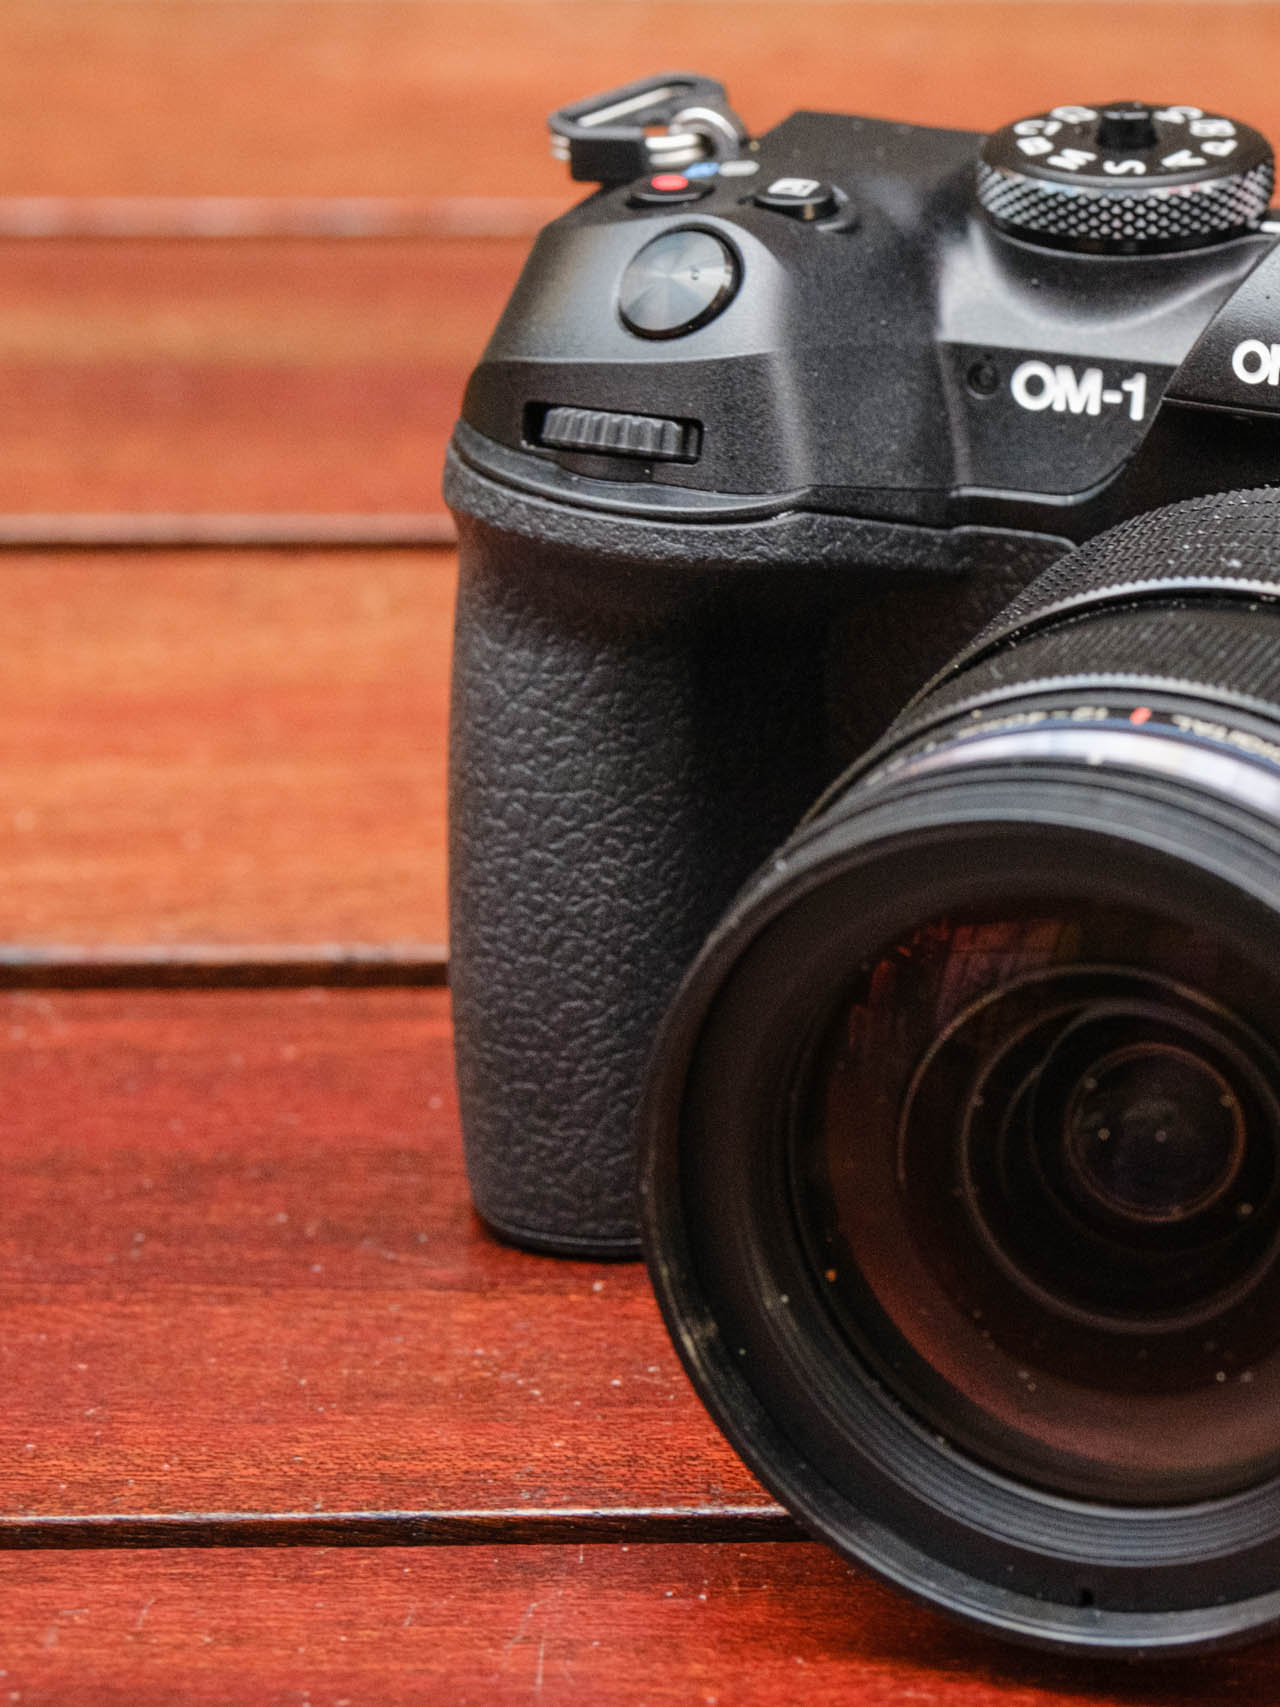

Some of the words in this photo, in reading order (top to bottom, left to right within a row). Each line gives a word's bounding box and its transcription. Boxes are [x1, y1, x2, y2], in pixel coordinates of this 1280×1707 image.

[1047, 148, 1097, 171] M
[1102, 159, 1146, 175] S
[1010, 360, 1147, 422] OM-1
